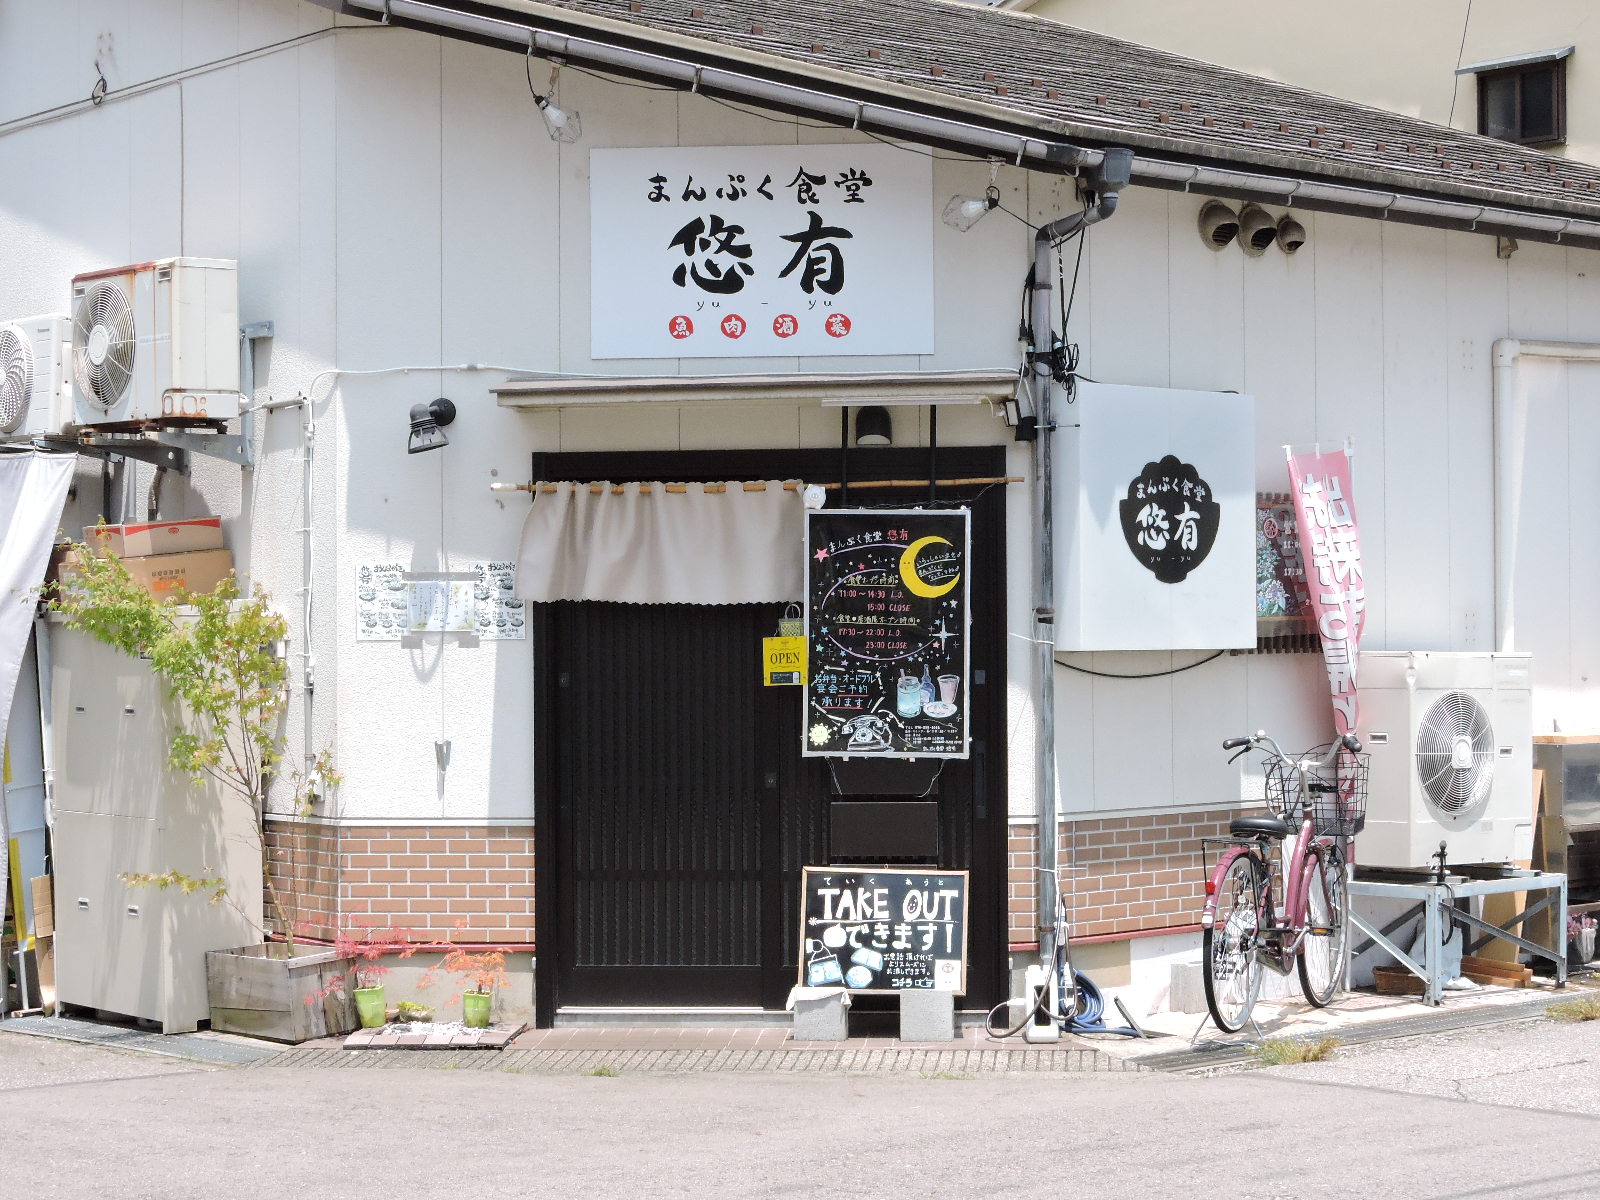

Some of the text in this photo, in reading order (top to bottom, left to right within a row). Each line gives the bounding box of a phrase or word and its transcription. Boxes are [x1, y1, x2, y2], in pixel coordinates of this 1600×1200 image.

[648, 166, 873, 204] まんぷく食堂
[667, 211, 853, 294] 悠有
[672, 317, 693, 337] 魚
[723, 315, 746, 336] 肉
[776, 315, 795, 337] 酒
[1136, 476, 1206, 502] まんぷく食堂
[1135, 501, 1200, 551] 悠有
[867, 603, 911, 612] 15:00 CLOSE
[770, 652, 800, 664] OPEN
[887, 641, 907, 649] CLOSE
[817, 887, 959, 921] TAKE OUT
